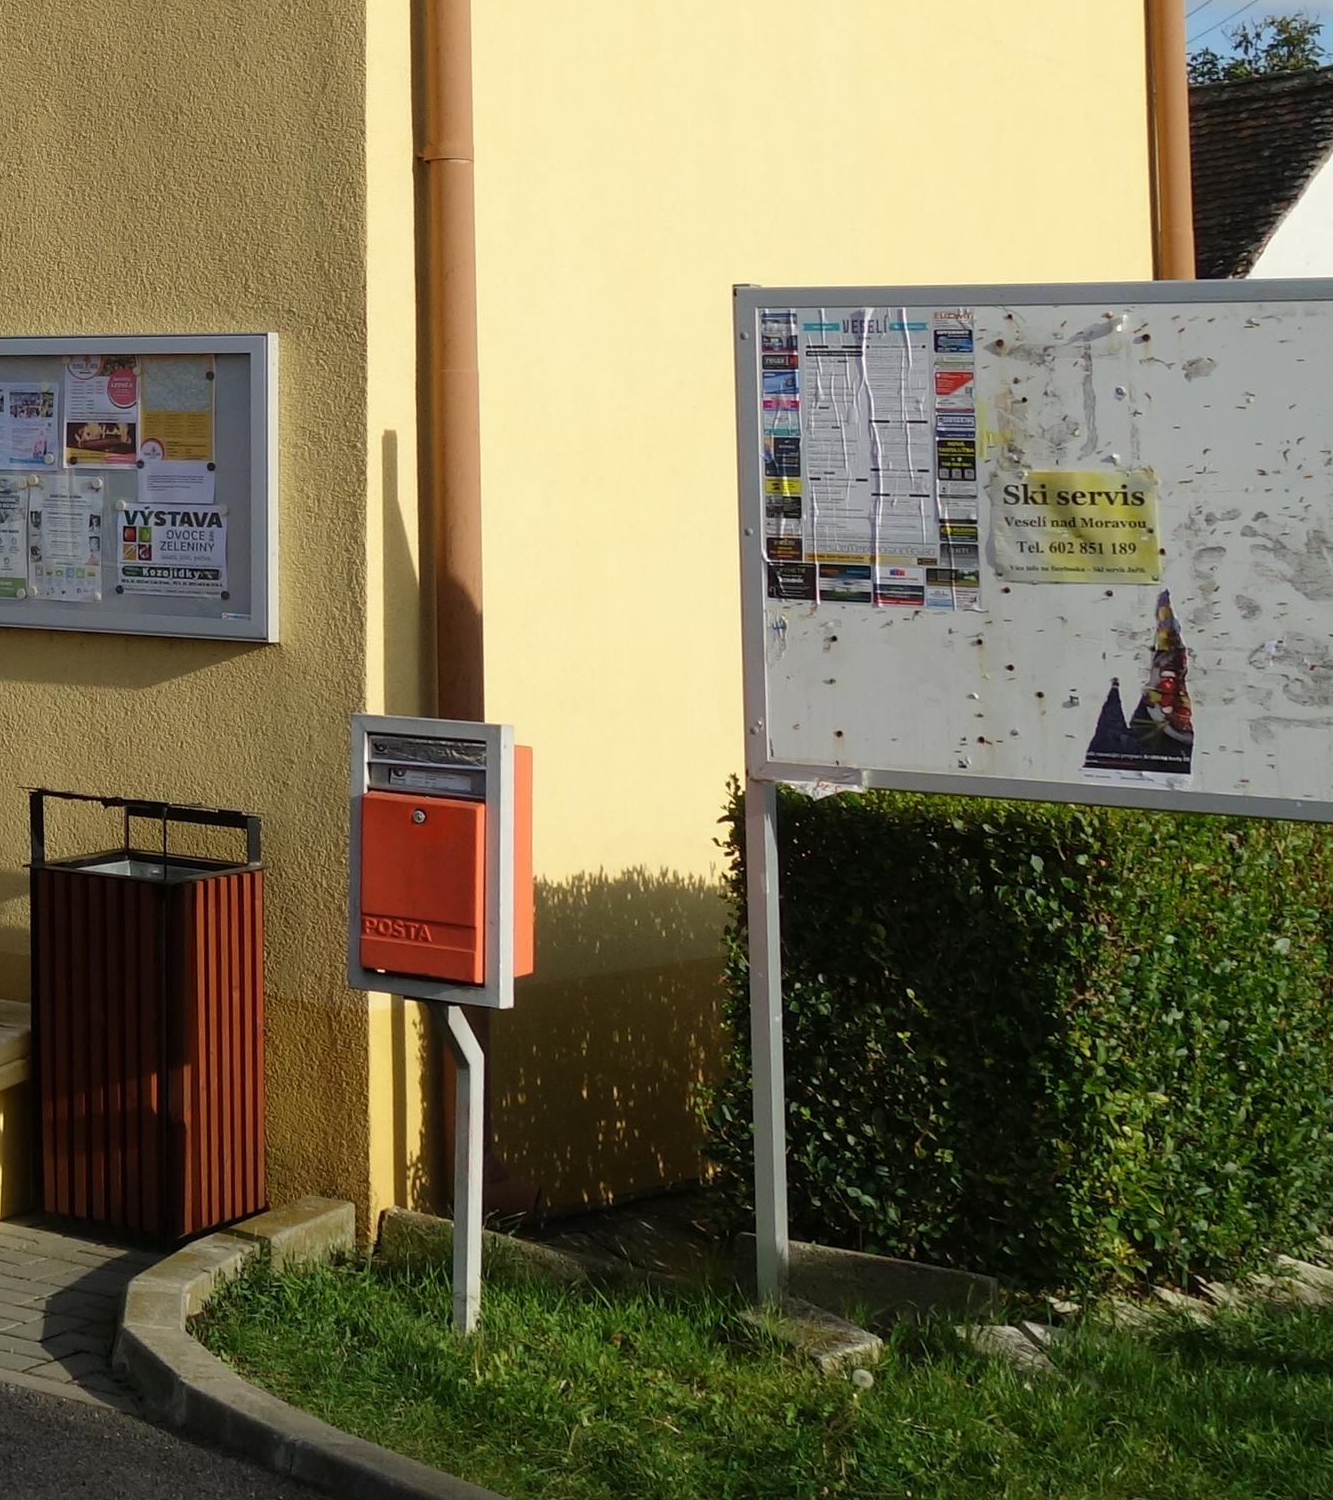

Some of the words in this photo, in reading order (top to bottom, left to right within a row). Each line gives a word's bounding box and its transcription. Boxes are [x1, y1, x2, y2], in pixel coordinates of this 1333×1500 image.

[1003, 483, 1049, 506] Ski
[1056, 483, 1146, 507] servis
[124, 506, 223, 528] VÝSTAVA
[1004, 516, 1047, 528] Veselí
[1051, 516, 1076, 529] nad
[1080, 517, 1147, 529] Moravou
[166, 529, 205, 541] OVOCE
[160, 540, 215, 553] ZELENINY
[1016, 540, 1044, 553] Tel.
[1049, 541, 1075, 554] 602
[1079, 542, 1103, 555] 851
[1111, 542, 1137, 556] 189
